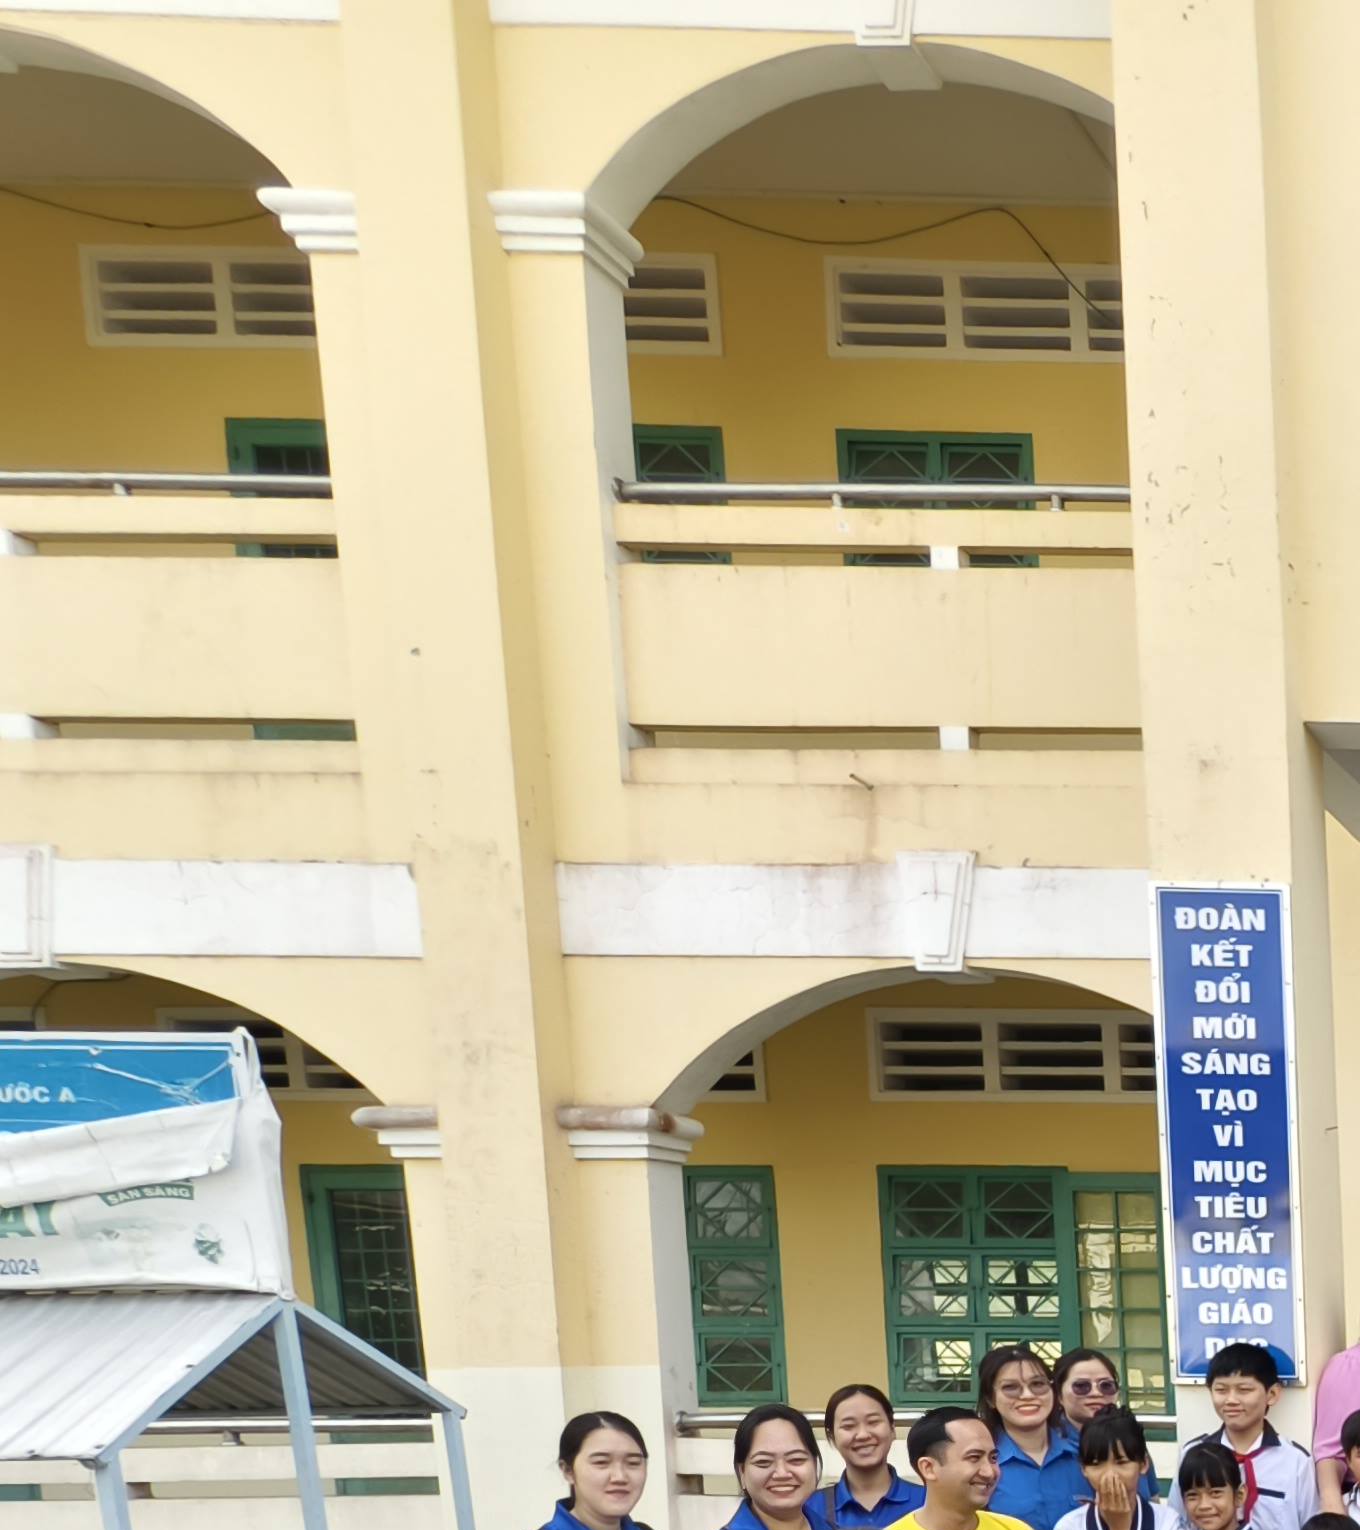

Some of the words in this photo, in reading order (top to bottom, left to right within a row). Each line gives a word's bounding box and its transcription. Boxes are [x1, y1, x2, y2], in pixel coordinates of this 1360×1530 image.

[1174, 903, 1265, 931] ĐOÀN
[1191, 938, 1253, 967] KẾT
[1195, 973, 1250, 1004] ĐỔI
[1193, 1013, 1256, 1040] MỚI
[1181, 1049, 1271, 1075] SÁNG
[1196, 1089, 1258, 1116] TẠO
[1212, 1121, 1244, 1147] VÌ
[1193, 1160, 1268, 1188] MỤC
[1194, 1192, 1268, 1219] TIÊU
[1192, 1225, 1274, 1254] CHẤT
[0, 1259, 40, 1275] 2024
[1181, 1264, 1287, 1294] LƯỢNG
[1198, 1299, 1273, 1325] GIÁO
